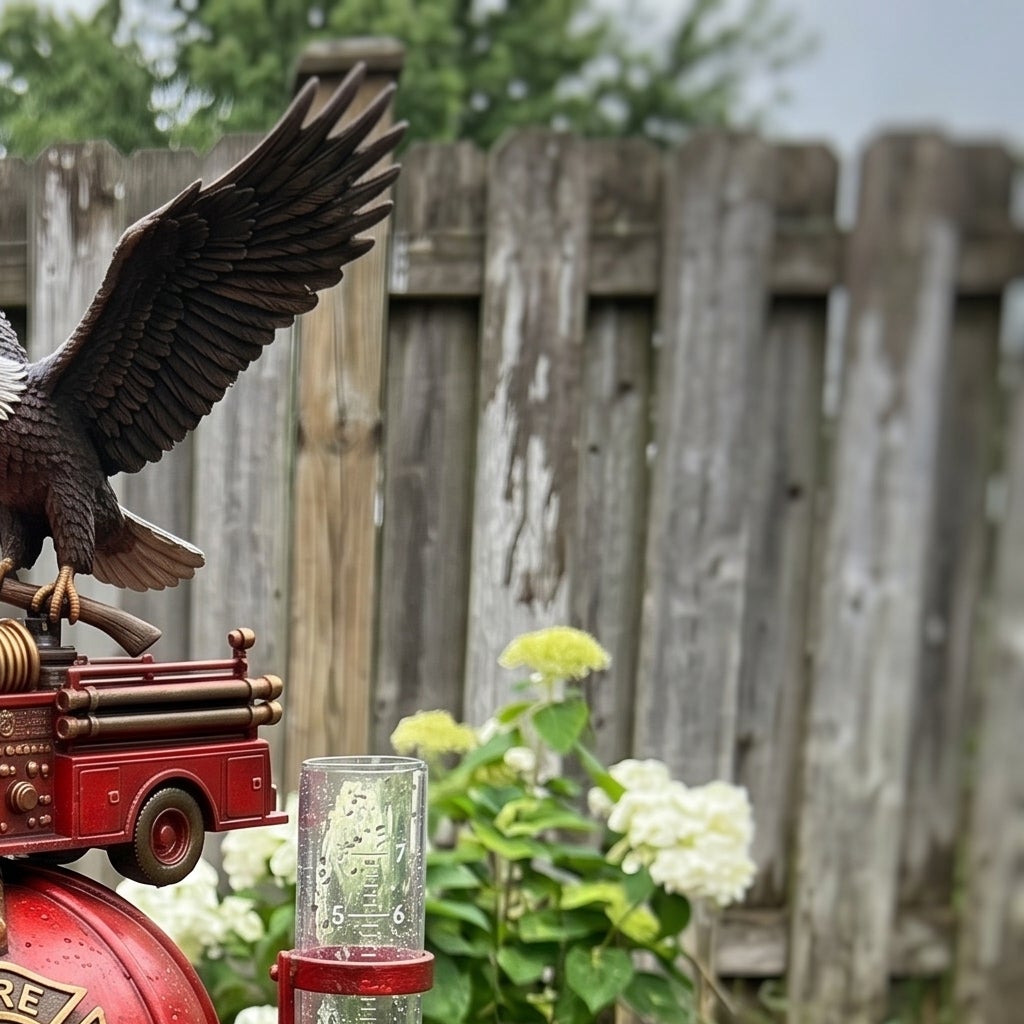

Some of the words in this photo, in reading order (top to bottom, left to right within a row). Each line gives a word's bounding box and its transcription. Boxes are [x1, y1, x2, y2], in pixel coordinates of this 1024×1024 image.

[395, 843, 405, 862] 7
[332, 905, 344, 925] 5
[393, 904, 405, 924] 6
